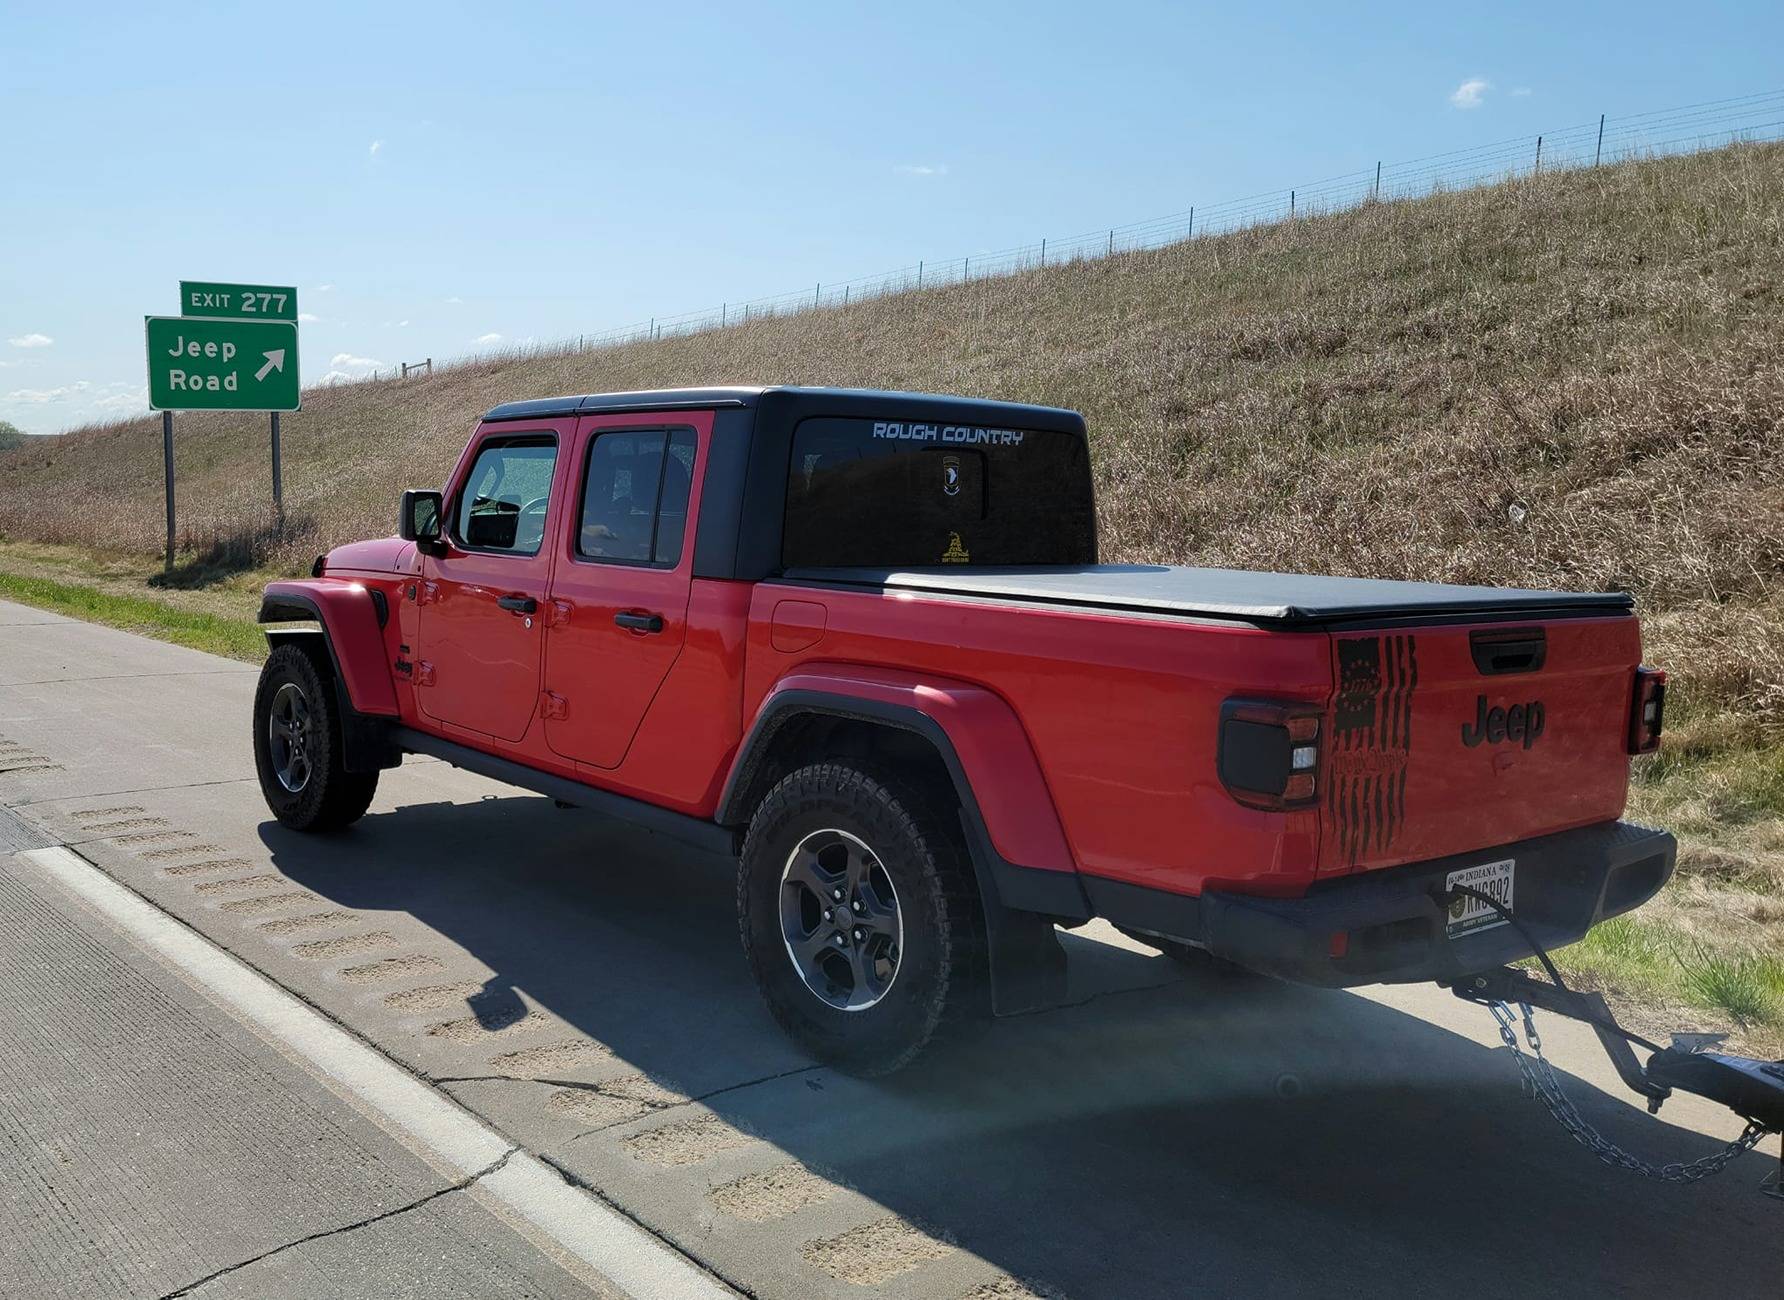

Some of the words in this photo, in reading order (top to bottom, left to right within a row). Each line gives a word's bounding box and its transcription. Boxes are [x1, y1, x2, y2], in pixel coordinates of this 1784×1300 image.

[191, 293, 231, 308] EXIT
[240, 292, 287, 313] 277
[168, 335, 236, 363] Jeep
[169, 369, 238, 391] Road
[872, 422, 938, 441] ROUGH
[942, 426, 1024, 446] COUNTRY
[1462, 694, 1546, 750] Jeep
[1465, 866, 1497, 882] INDIANA
